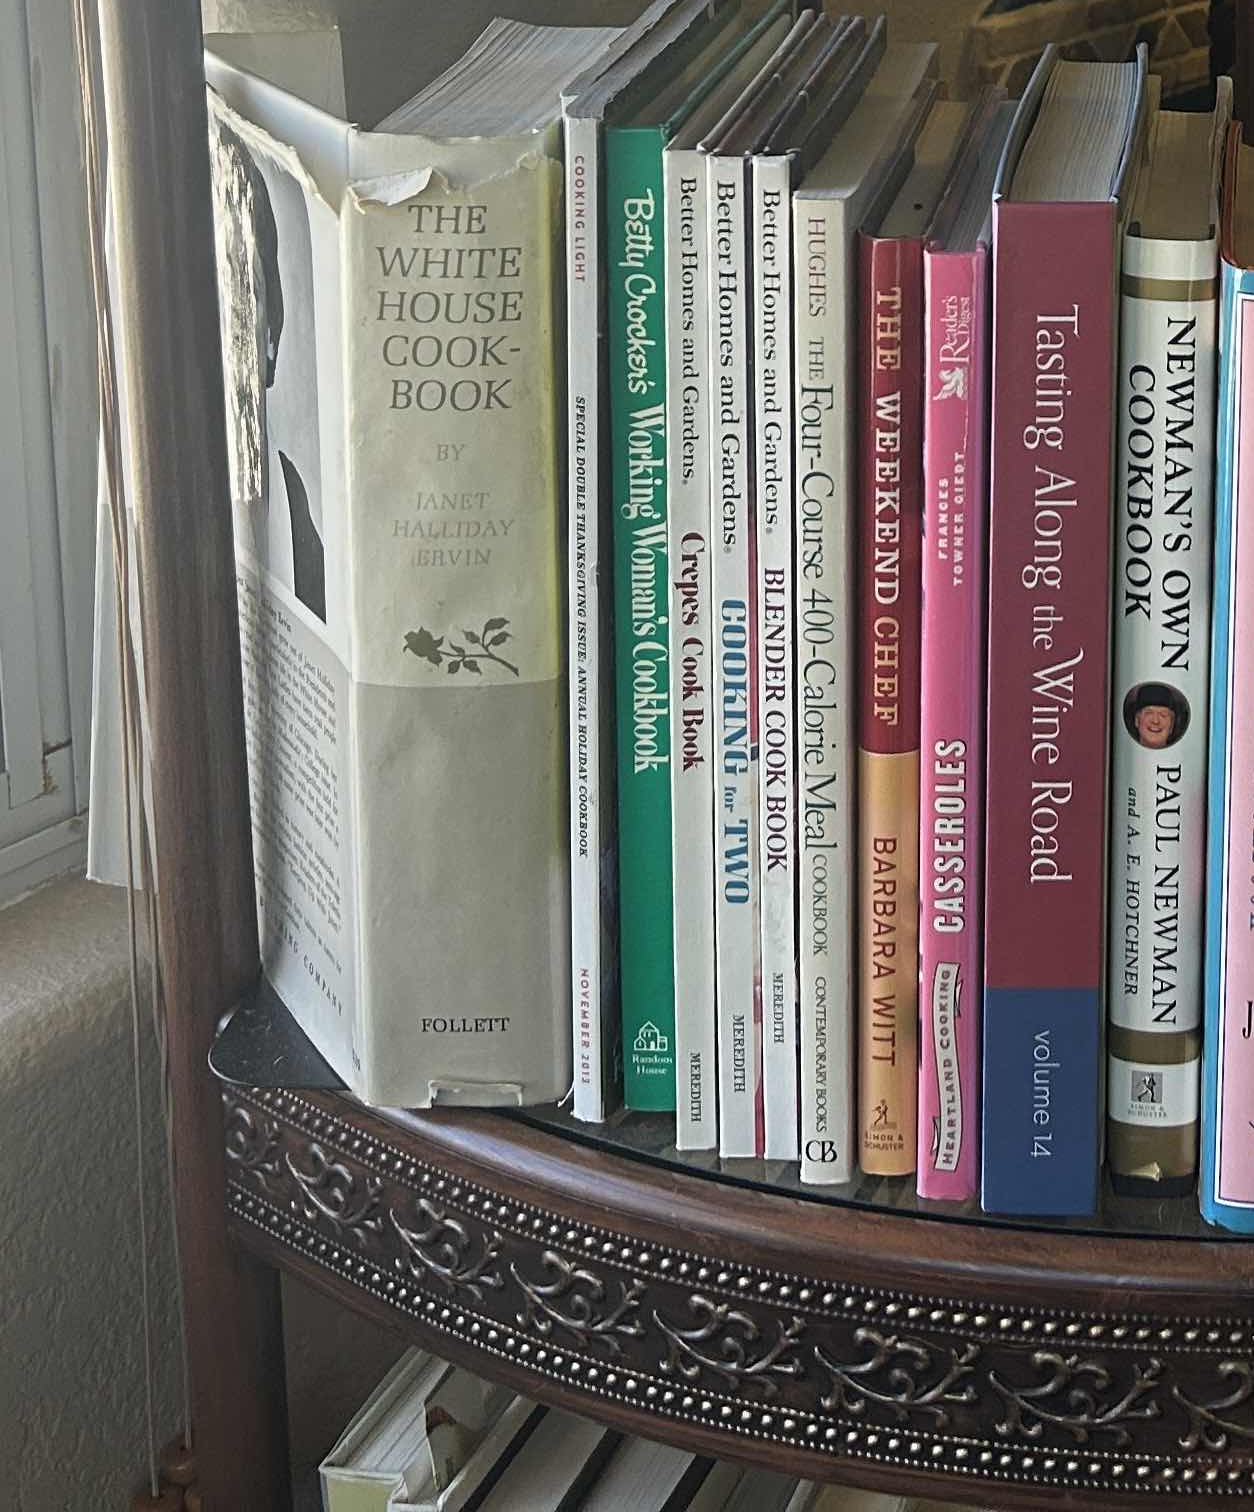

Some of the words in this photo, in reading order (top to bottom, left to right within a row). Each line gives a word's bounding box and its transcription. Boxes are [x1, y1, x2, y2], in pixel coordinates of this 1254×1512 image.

[409, 205, 488, 234] THE
[573, 155, 586, 230] COOKING
[376, 246, 523, 279] WHITE
[574, 235, 586, 282] LIGHT
[807, 217, 827, 318] HUGHES
[376, 291, 523, 324] HOUSE
[875, 289, 901, 373] THE
[382, 335, 522, 368] COOK-
[808, 336, 825, 380] THE
[1023, 303, 1080, 451] Tasting
[390, 379, 513, 412] BOOK
[574, 396, 587, 452] SPECIAL
[437, 445, 464, 462] BY
[1162, 316, 1197, 554] NEWMAN'S
[416, 492, 490, 511] JANET
[575, 457, 588, 511] DOUBLE
[800, 384, 834, 580] Four-Course
[873, 391, 901, 606] WEEKEND
[1123, 364, 1156, 620] COOKBOOK
[393, 519, 515, 539] HALLIDAY
[416, 548, 491, 566] ERVIN
[1022, 464, 1078, 590] Along
[576, 514, 589, 617] THANKSGIVING
[673, 532, 706, 627] Crepes
[577, 621, 589, 662] ISSUE:
[764, 568, 786, 704] BLENDER
[1032, 605, 1064, 651] the
[1160, 569, 1191, 671] OWN
[577, 666, 589, 722] ANNUAL
[681, 637, 705, 702] Cook
[802, 588, 838, 765] 400-Calorie
[873, 616, 900, 727] CHEF
[1031, 648, 1084, 765] Wine
[577, 725, 590, 782] HOLIDAY
[681, 708, 705, 773] Book
[764, 709, 787, 787] COOK
[578, 785, 591, 857] COOKBOOK
[766, 795, 788, 873] BOOK
[803, 772, 838, 851] Meal
[933, 739, 968, 934] CASSEROLES
[1030, 781, 1073, 884] Road
[1155, 764, 1182, 853] PAUL
[811, 854, 828, 957] COOKBOOK
[872, 837, 898, 980] BARBARA
[1151, 863, 1180, 1025] NEWMAN
[421, 1016, 510, 1034] FOLLETT
[772, 972, 785, 1044] MEREDITH
[813, 976, 827, 1089] CONTEMPORARY
[872, 994, 897, 1067] WITT
[690, 1053, 701, 1123] MEREDITH
[732, 1015, 746, 1093] MEREDITH
[1033, 1029, 1060, 1126] volume
[814, 1091, 827, 1133] BOOKS
[1030, 1132, 1051, 1158] 14
